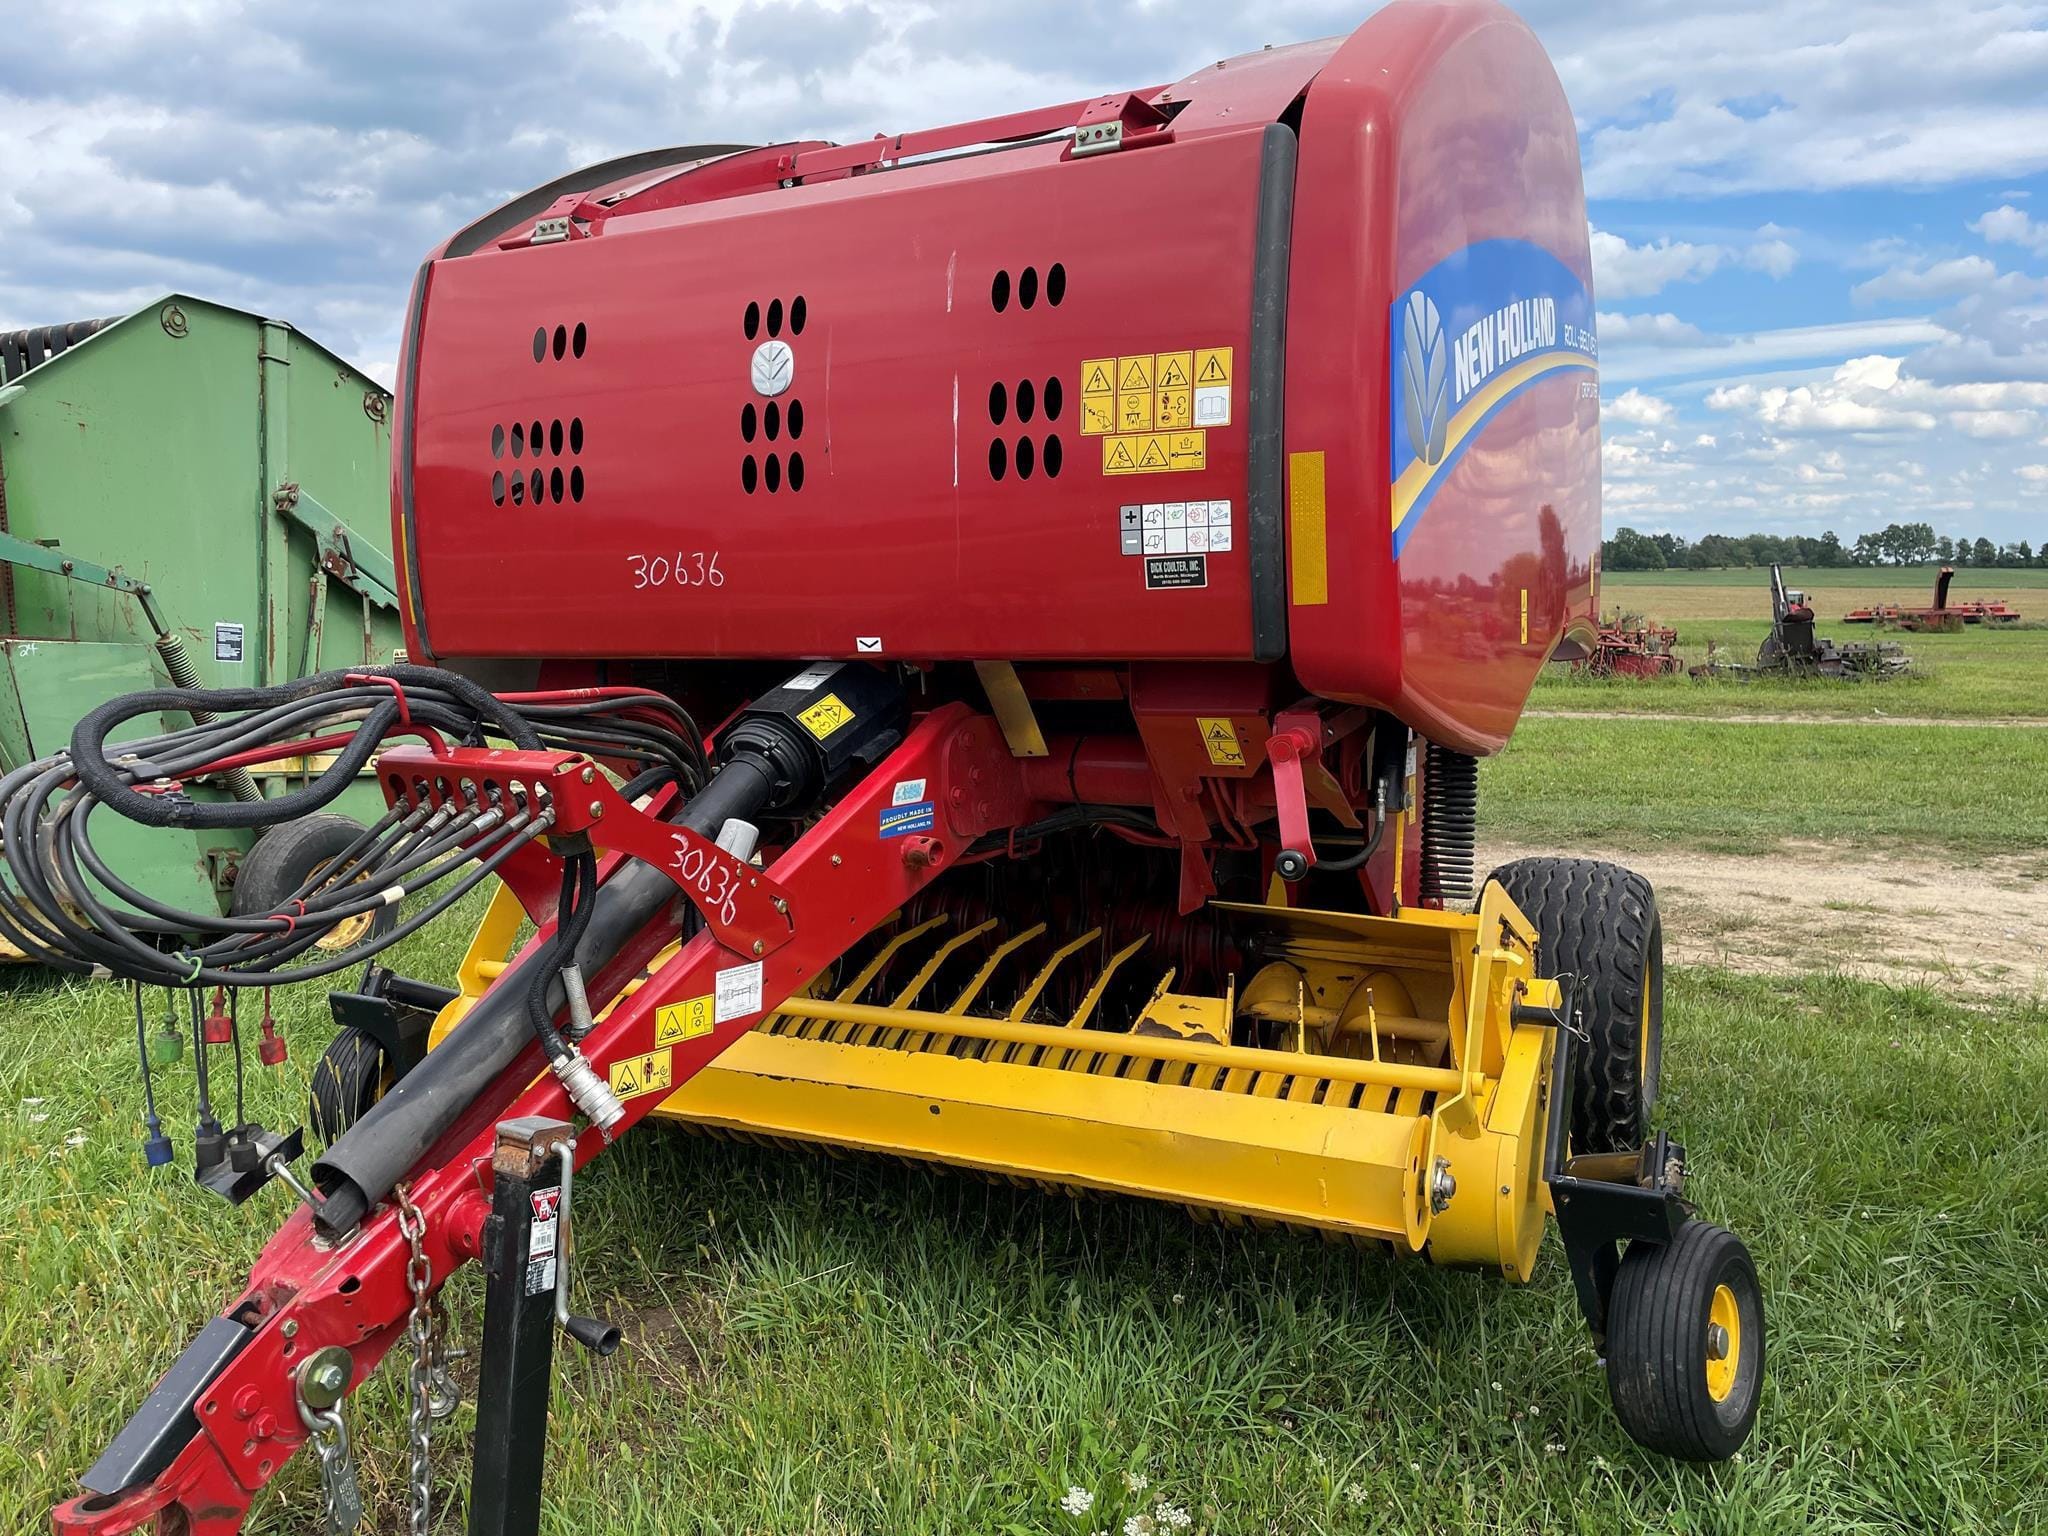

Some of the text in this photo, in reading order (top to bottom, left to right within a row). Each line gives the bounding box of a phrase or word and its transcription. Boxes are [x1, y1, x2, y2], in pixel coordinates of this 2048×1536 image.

[1454, 297, 1556, 403] NEW HOLLAND
[626, 551, 724, 589] 30636
[1150, 562, 1163, 574] DICK
[1189, 559, 1201, 571] INC.
[882, 812, 907, 825] PROUDLY
[909, 808, 924, 816] MADE
[668, 832, 740, 926] 30636
